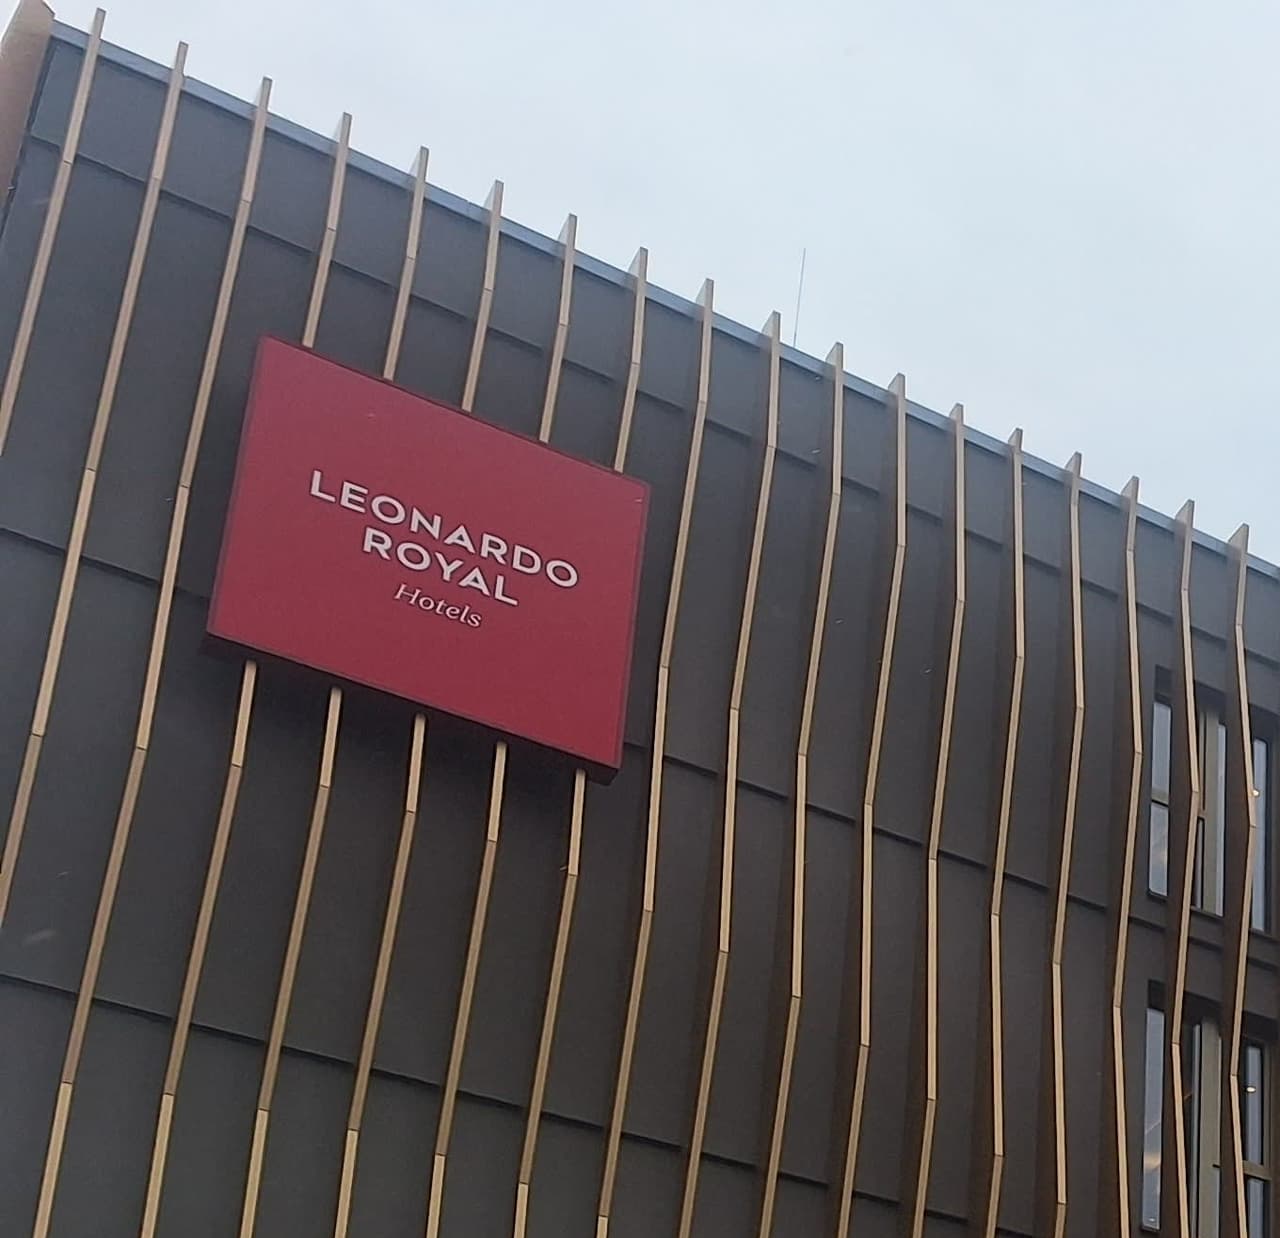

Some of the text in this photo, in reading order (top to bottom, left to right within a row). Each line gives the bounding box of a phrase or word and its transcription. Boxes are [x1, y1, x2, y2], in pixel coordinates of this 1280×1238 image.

[309, 470, 579, 588] LEONARDO
[362, 526, 519, 606] ROYAL
[393, 583, 482, 628] Hotels
